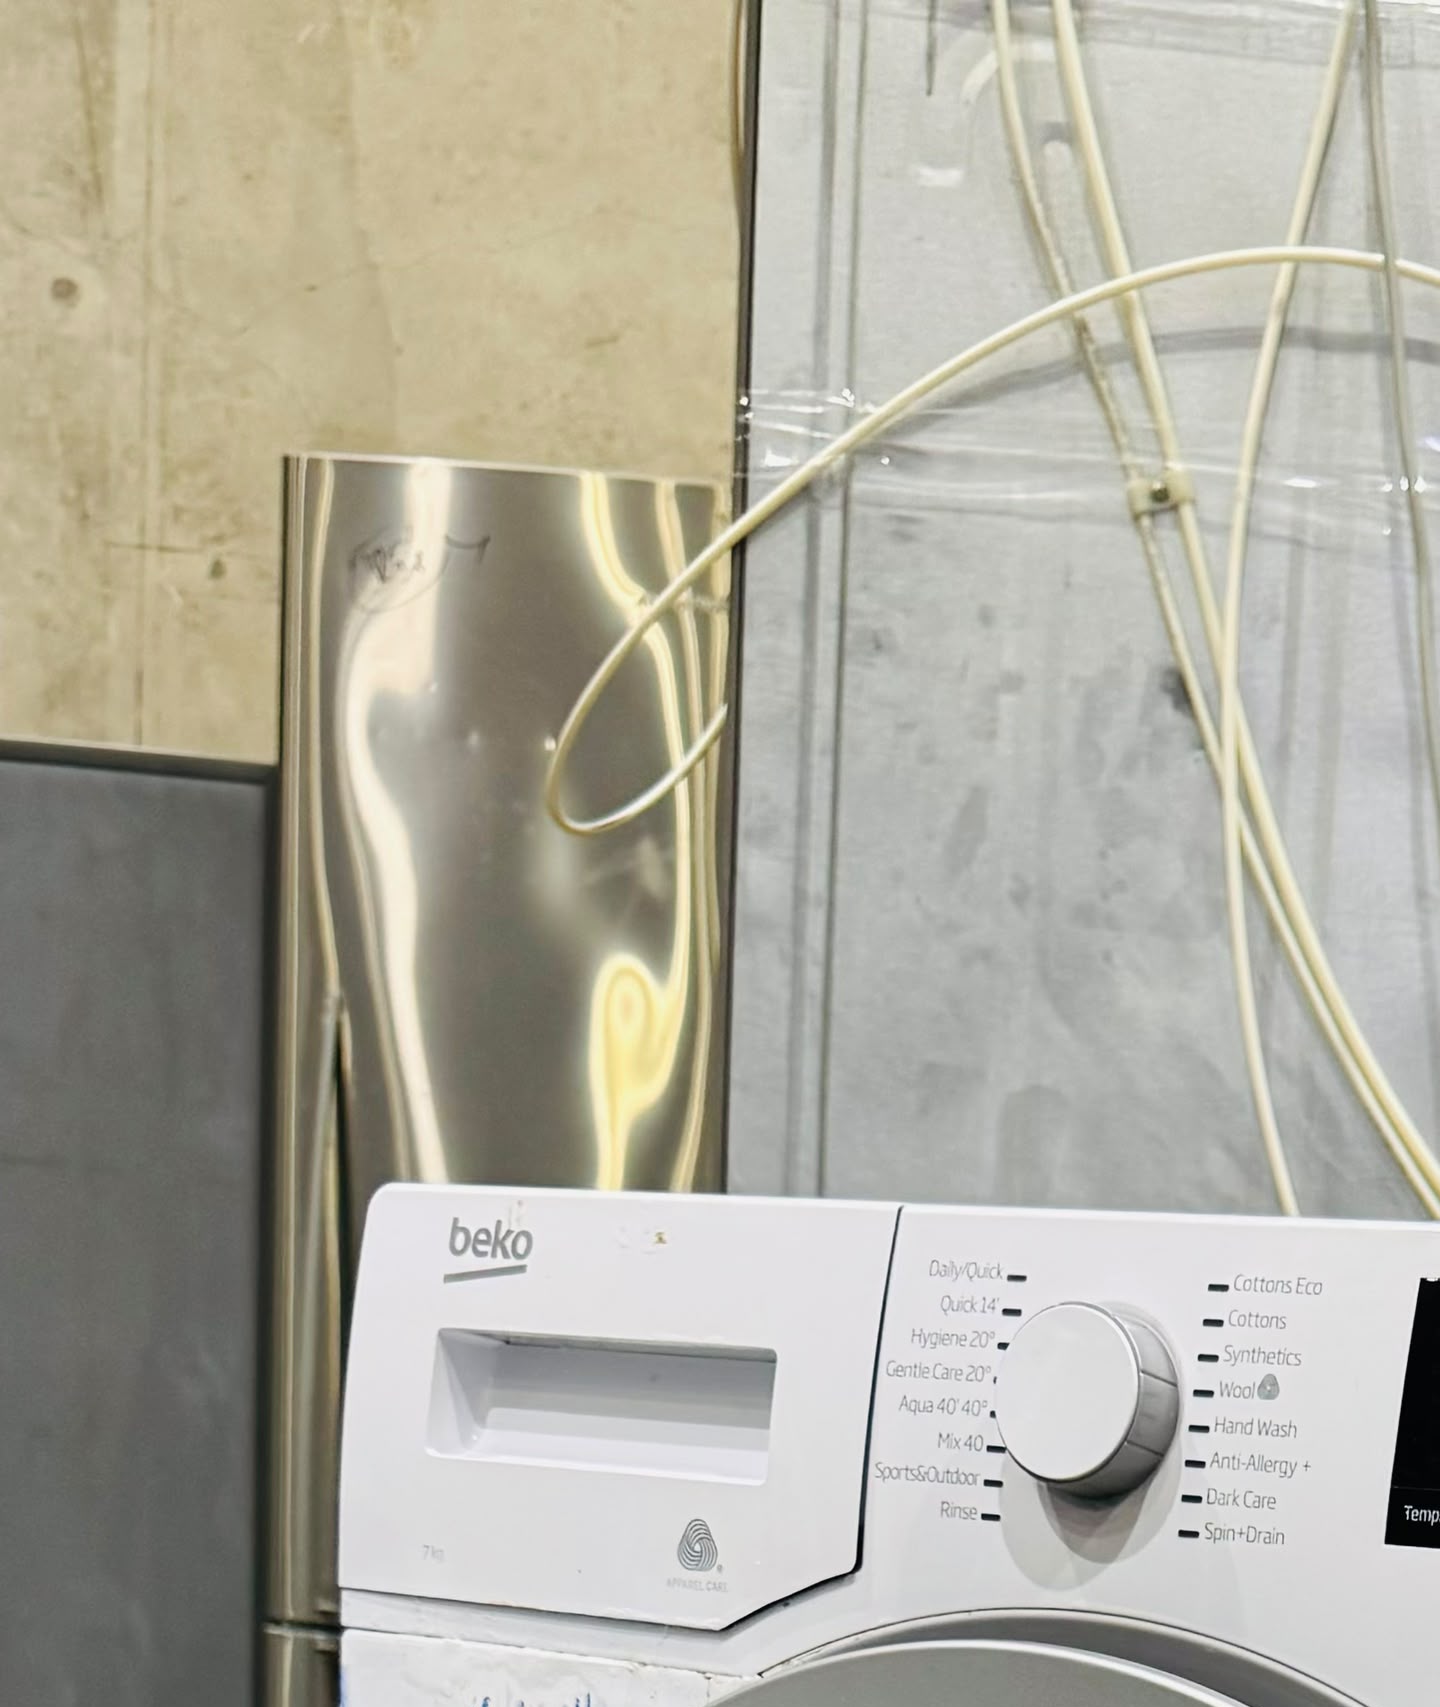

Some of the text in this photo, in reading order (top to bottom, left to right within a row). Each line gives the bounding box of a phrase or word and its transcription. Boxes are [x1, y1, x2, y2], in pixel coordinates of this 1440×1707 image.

[448, 1216, 533, 1262] beko
[928, 1259, 1004, 1282] Daily/Quick
[1233, 1273, 1323, 1296] Cottons Eco
[940, 1294, 978, 1316] Quick
[1228, 1309, 1288, 1330] Cottons
[911, 1328, 968, 1350] Hygiene
[1223, 1344, 1302, 1367] Synthetics
[886, 1360, 931, 1380] Gentle
[932, 1362, 964, 1382] Care
[1219, 1380, 1256, 1400] Wool
[898, 1395, 934, 1416] Aqua
[1214, 1416, 1298, 1439] Hand Wash
[937, 1432, 985, 1453] Mix 40
[874, 1461, 981, 1487] Sports&Outdoor
[1209, 1451, 1298, 1480] Anti-Allergy
[1206, 1487, 1277, 1510] Dark Care
[940, 1500, 979, 1521] Rinse
[1204, 1521, 1286, 1545] Spin+Drain
